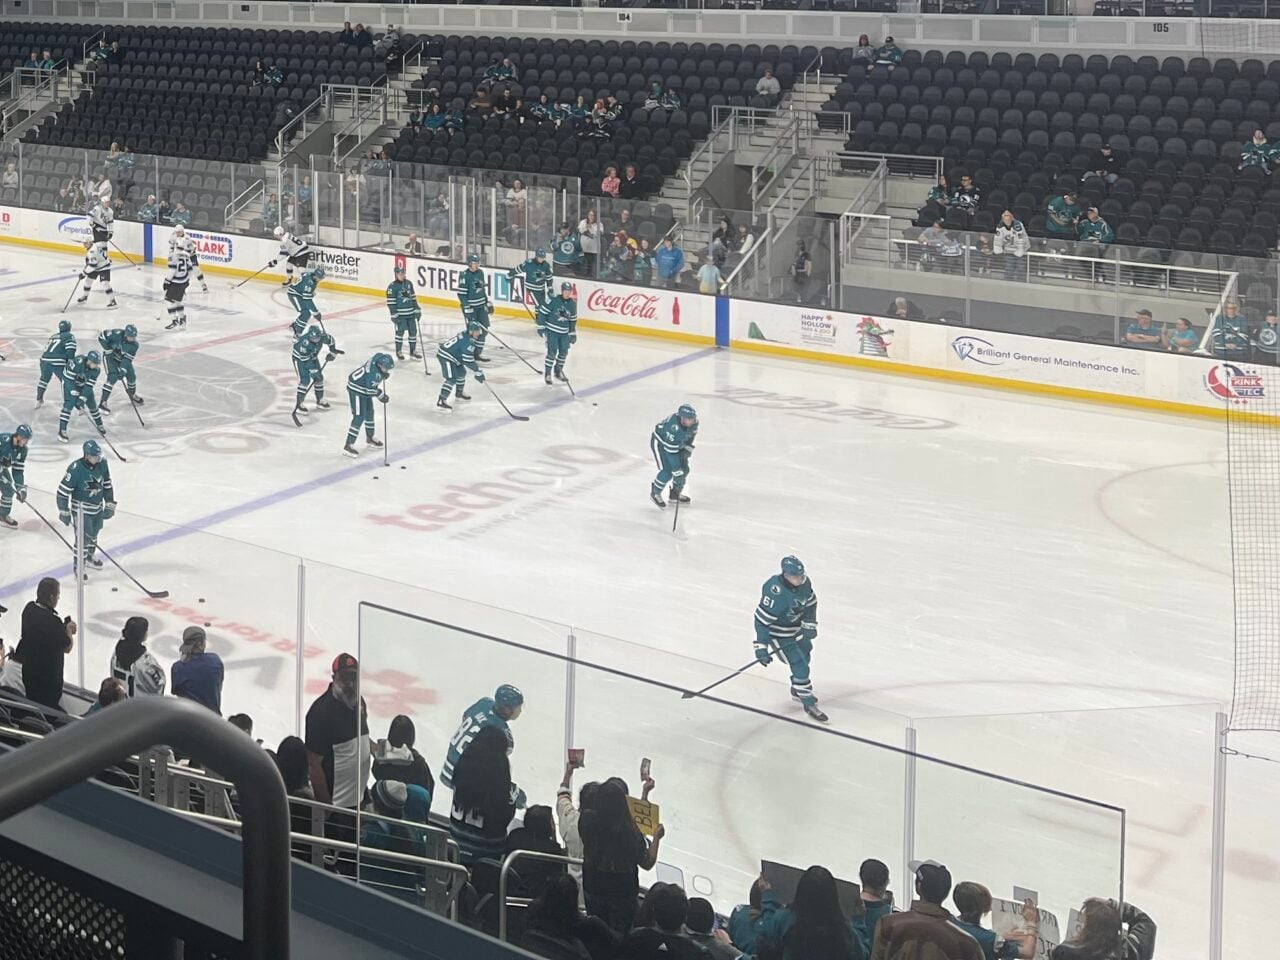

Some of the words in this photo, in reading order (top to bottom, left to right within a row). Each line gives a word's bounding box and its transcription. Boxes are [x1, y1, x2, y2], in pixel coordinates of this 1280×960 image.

[1153, 22, 1169, 33] 105
[308, 250, 361, 267] artwater
[587, 288, 660, 320] Coca-Cola
[801, 320, 832, 329] HOLLOW
[976, 347, 1012, 359] Brilliant
[1013, 352, 1052, 365] General
[1054, 357, 1119, 374] Maintenance
[1121, 365, 1140, 376] Inc.
[762, 595, 775, 609] 61
